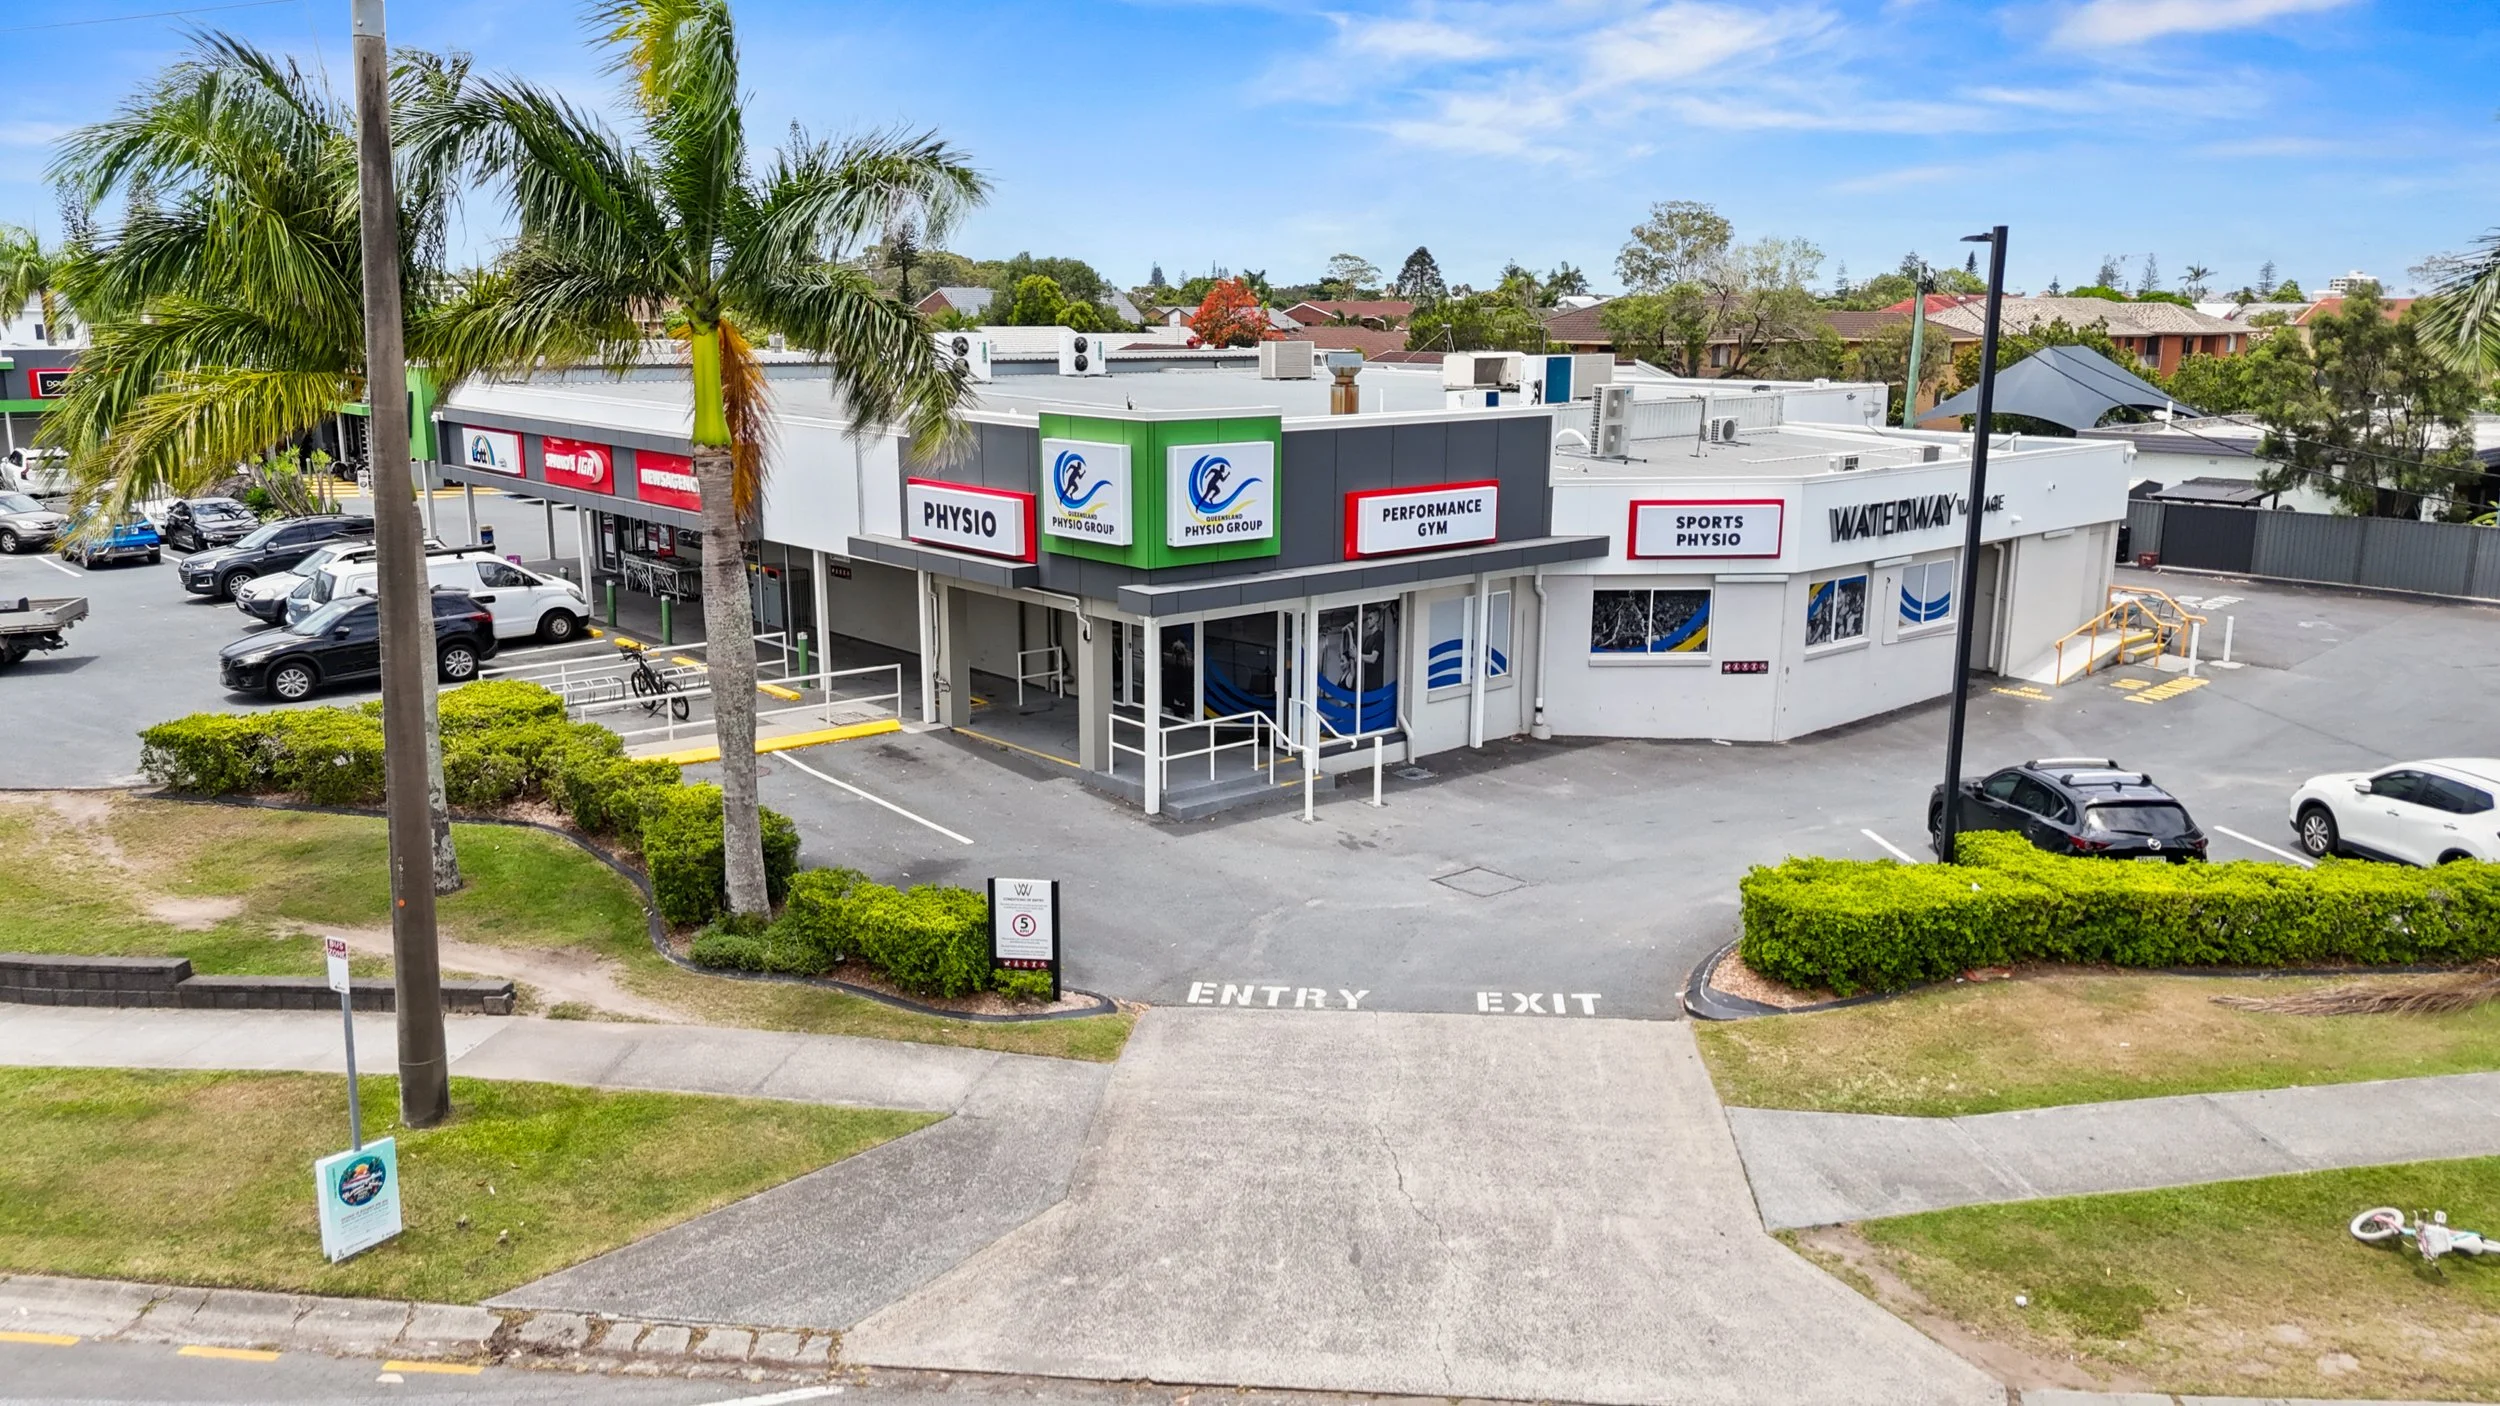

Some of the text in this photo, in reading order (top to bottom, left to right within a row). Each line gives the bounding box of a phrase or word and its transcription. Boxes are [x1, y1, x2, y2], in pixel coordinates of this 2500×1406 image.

[576, 455, 595, 477] IGA
[641, 468, 701, 494] NEWSAGENC
[924, 501, 997, 538] PHYSIO
[1067, 510, 1098, 520] QUEENSLAND
[1206, 513, 1243, 523] QUEENSLAND
[1382, 498, 1482, 523] PERFORMANCE
[1828, 492, 2006, 543] WATERWAY VAGE
[1052, 516, 1115, 535] PHYSIO GROUP
[1185, 519, 1263, 537] PHYSIO GROUP
[1418, 520, 1448, 537] GYM
[1676, 515, 1744, 529] SPORTS
[1676, 533, 1741, 546] PHYSIO
[1020, 917, 1029, 930] 5
[328, 949, 347, 960] ZONE
[329, 940, 344, 951] BUS
[1187, 981, 1371, 1010] ENTRY
[1476, 991, 1602, 1016] EXIT
